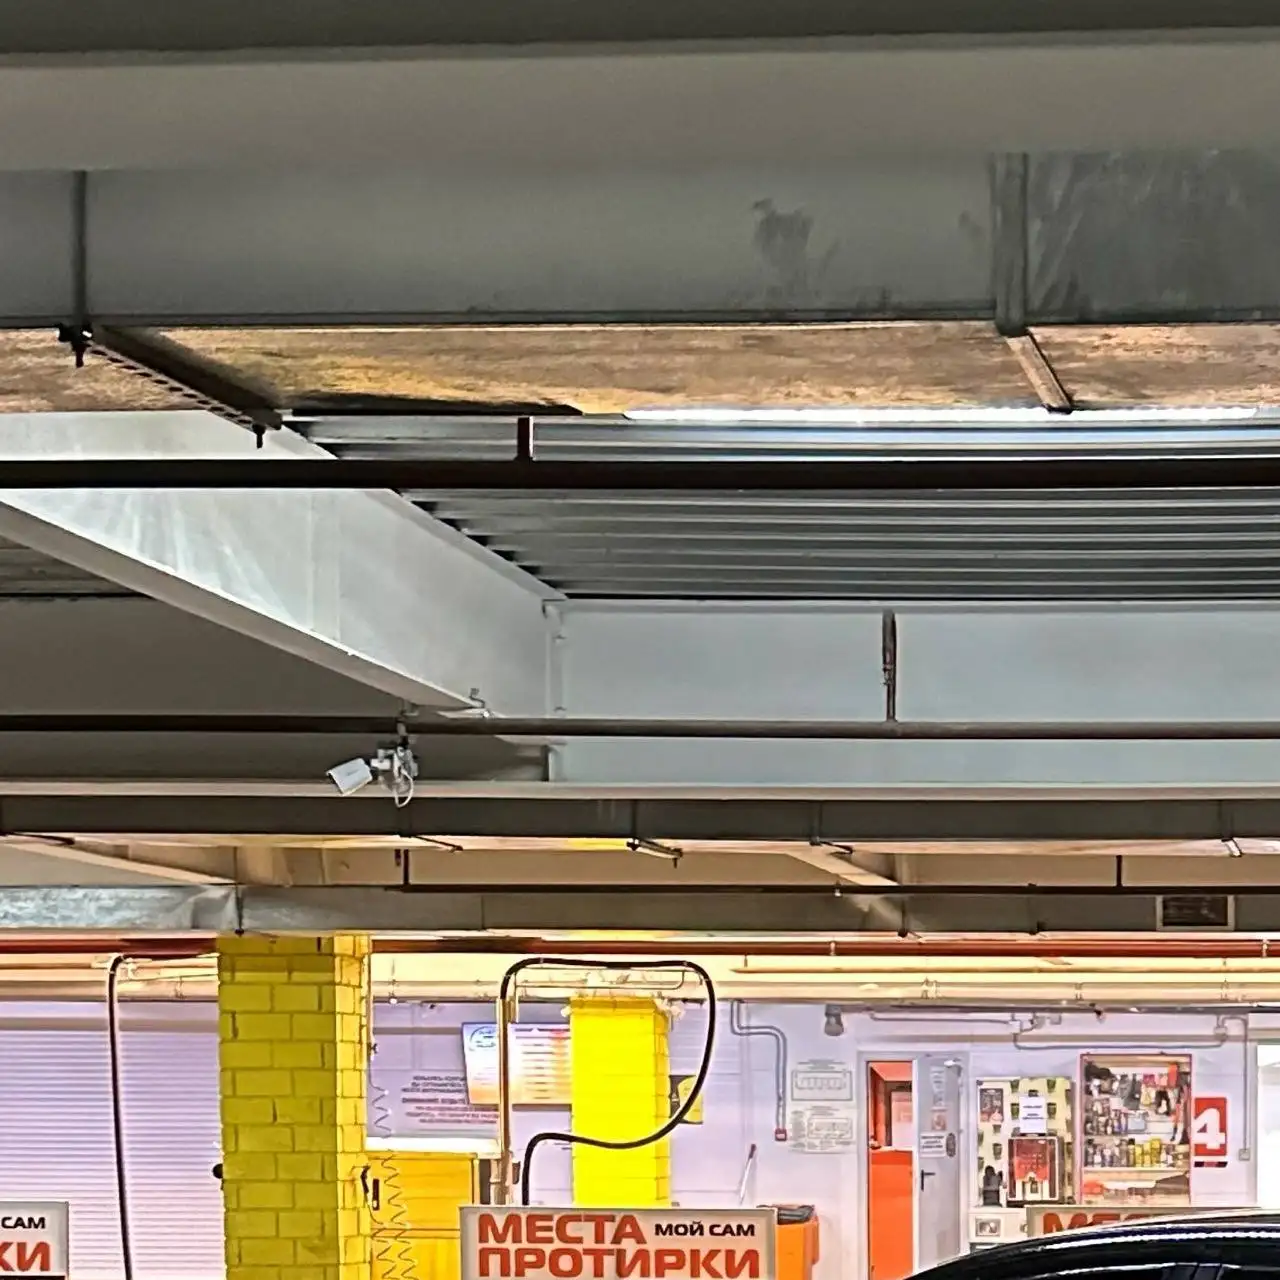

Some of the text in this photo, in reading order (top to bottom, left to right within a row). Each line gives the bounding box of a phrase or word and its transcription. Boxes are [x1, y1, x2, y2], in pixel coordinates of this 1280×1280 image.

[1193, 1108, 1226, 1149] 4
[1, 1216, 46, 1229] САМ
[478, 1213, 647, 1245] МЕСТА
[654, 1221, 755, 1237] МОЙ САМ
[478, 1247, 760, 1279] ПРОТИРКИ
